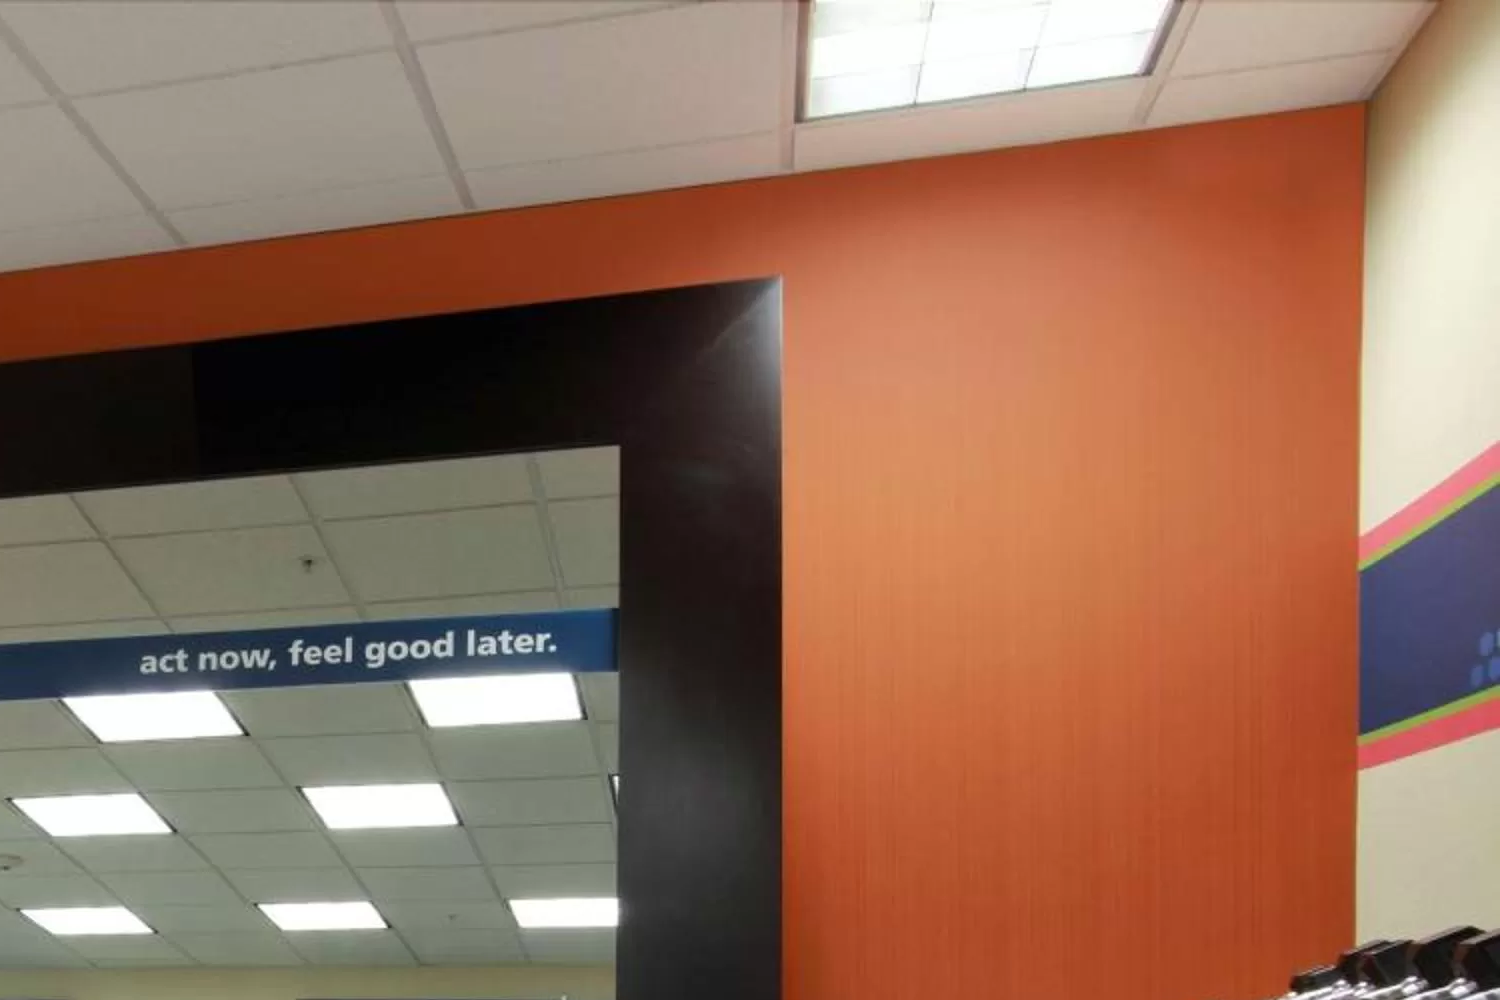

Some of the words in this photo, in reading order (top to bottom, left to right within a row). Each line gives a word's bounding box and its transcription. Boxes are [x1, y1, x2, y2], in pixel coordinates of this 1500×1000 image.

[140, 650, 188, 674] act
[198, 647, 277, 672] now,
[288, 637, 353, 667] feel
[365, 630, 455, 667] good
[467, 629, 557, 655] later.
